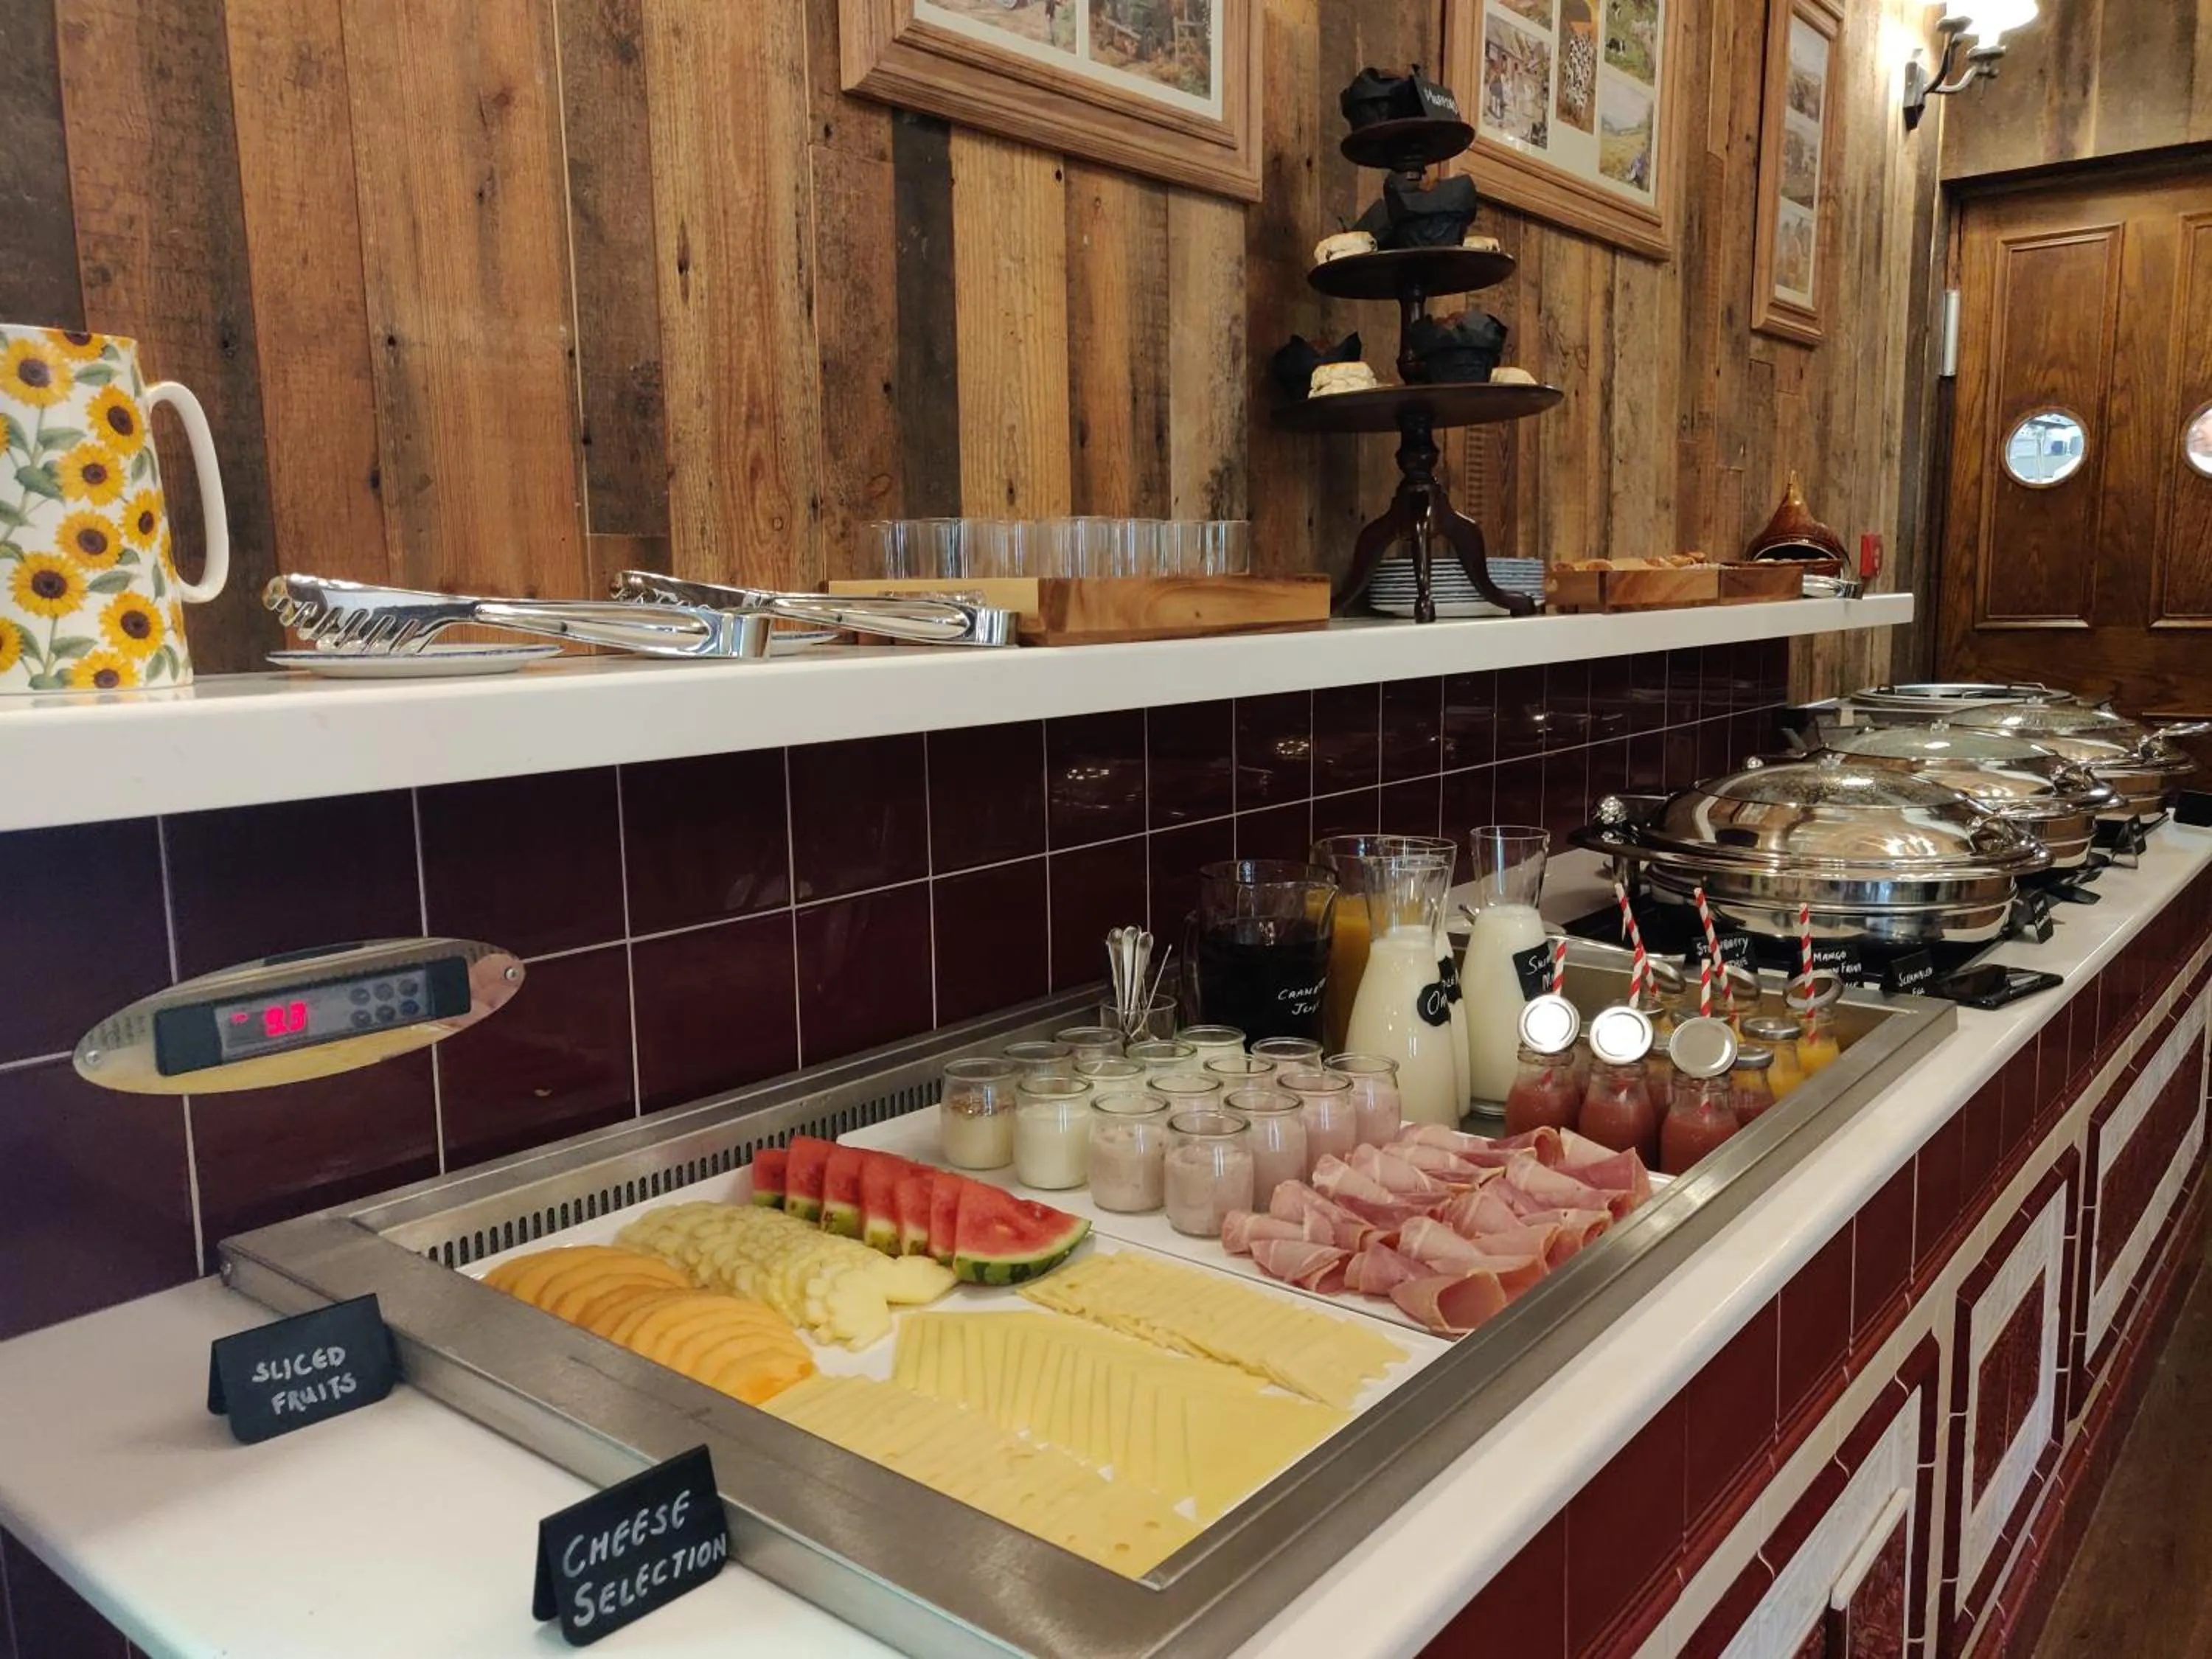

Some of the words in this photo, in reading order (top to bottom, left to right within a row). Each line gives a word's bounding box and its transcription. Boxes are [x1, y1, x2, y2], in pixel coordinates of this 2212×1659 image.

[251, 1346, 346, 1382] SLICED
[271, 1372, 357, 1415] FRUITS
[563, 1490, 690, 1578] CHEESE
[574, 1532, 726, 1627] SELECTION
